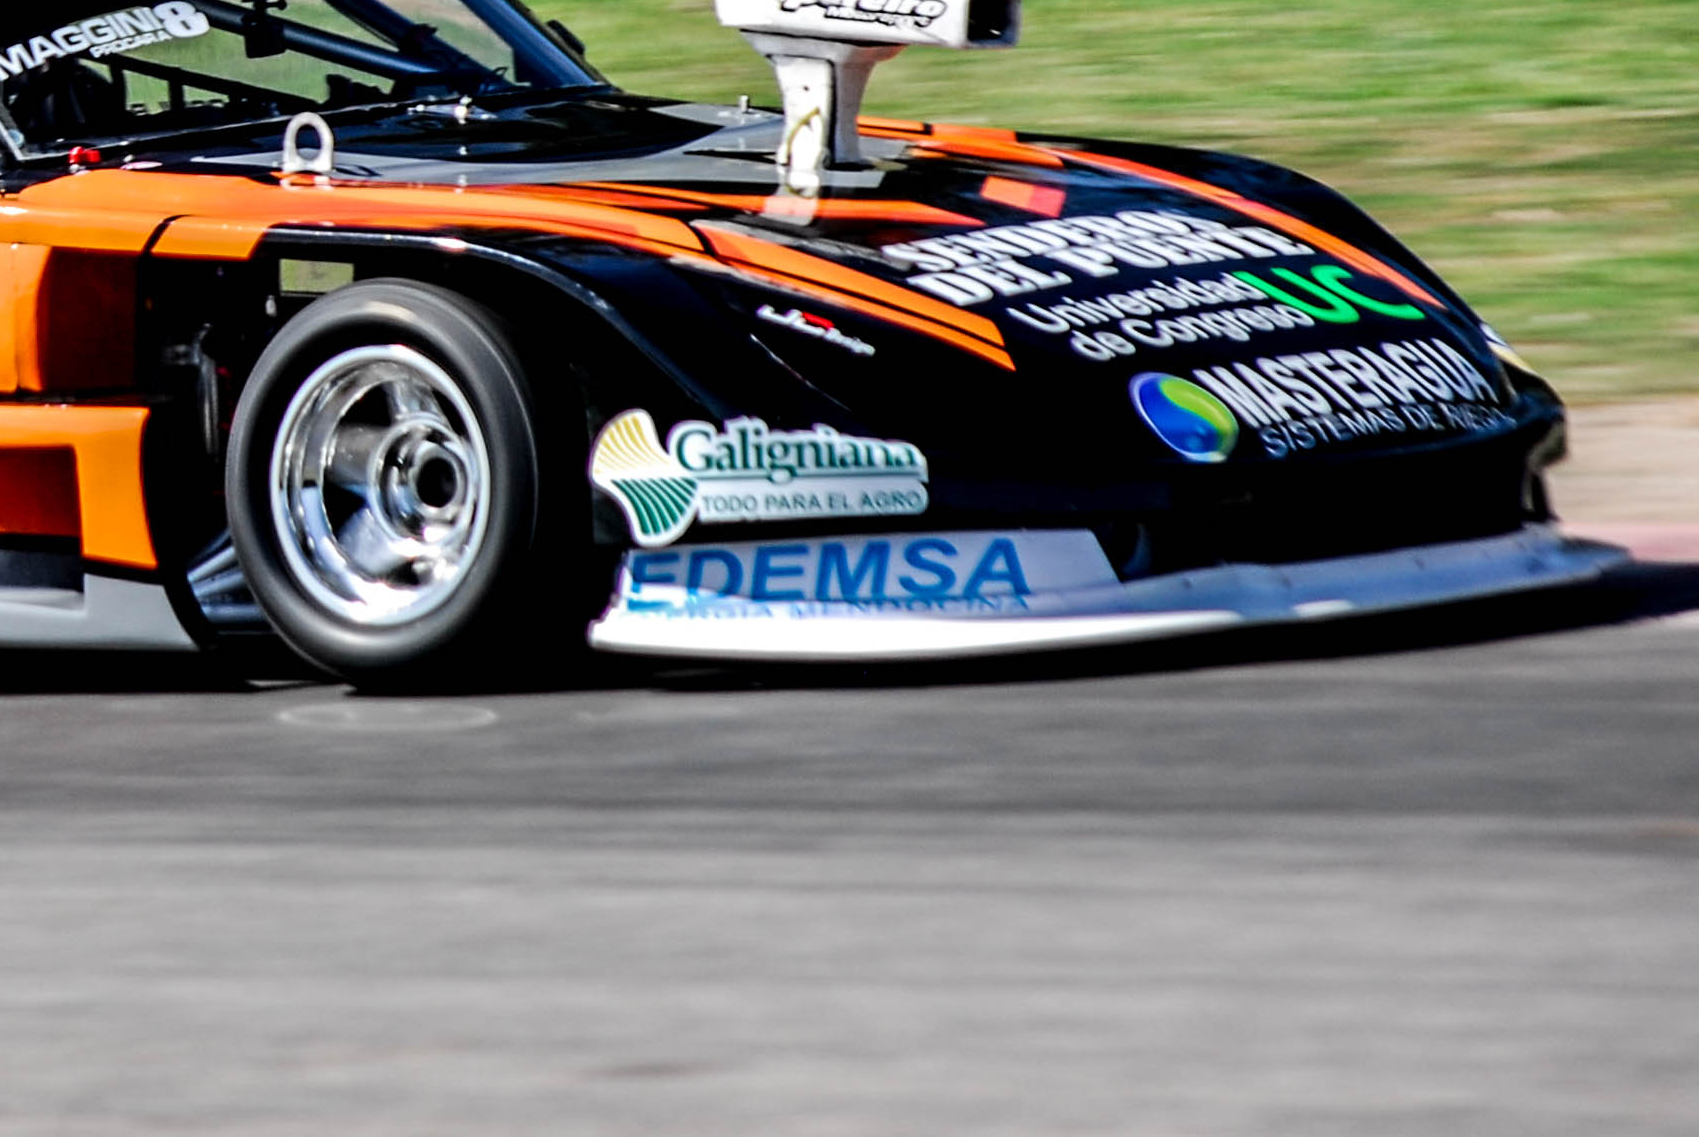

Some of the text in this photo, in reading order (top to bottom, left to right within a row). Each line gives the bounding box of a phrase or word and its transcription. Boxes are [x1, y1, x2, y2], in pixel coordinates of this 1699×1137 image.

[153, 1, 210, 38] 8
[906, 259, 1073, 306] DEL
[1006, 272, 1270, 333] Universidad
[1233, 265, 1426, 324] UC
[1071, 304, 1315, 361] de Congreso
[1193, 337, 1499, 429] MASTERAGUA
[677, 425, 918, 483] Galigniana
[1258, 404, 1405, 459] SISTEMAS
[704, 490, 920, 512] TODO PARA EL AGRO
